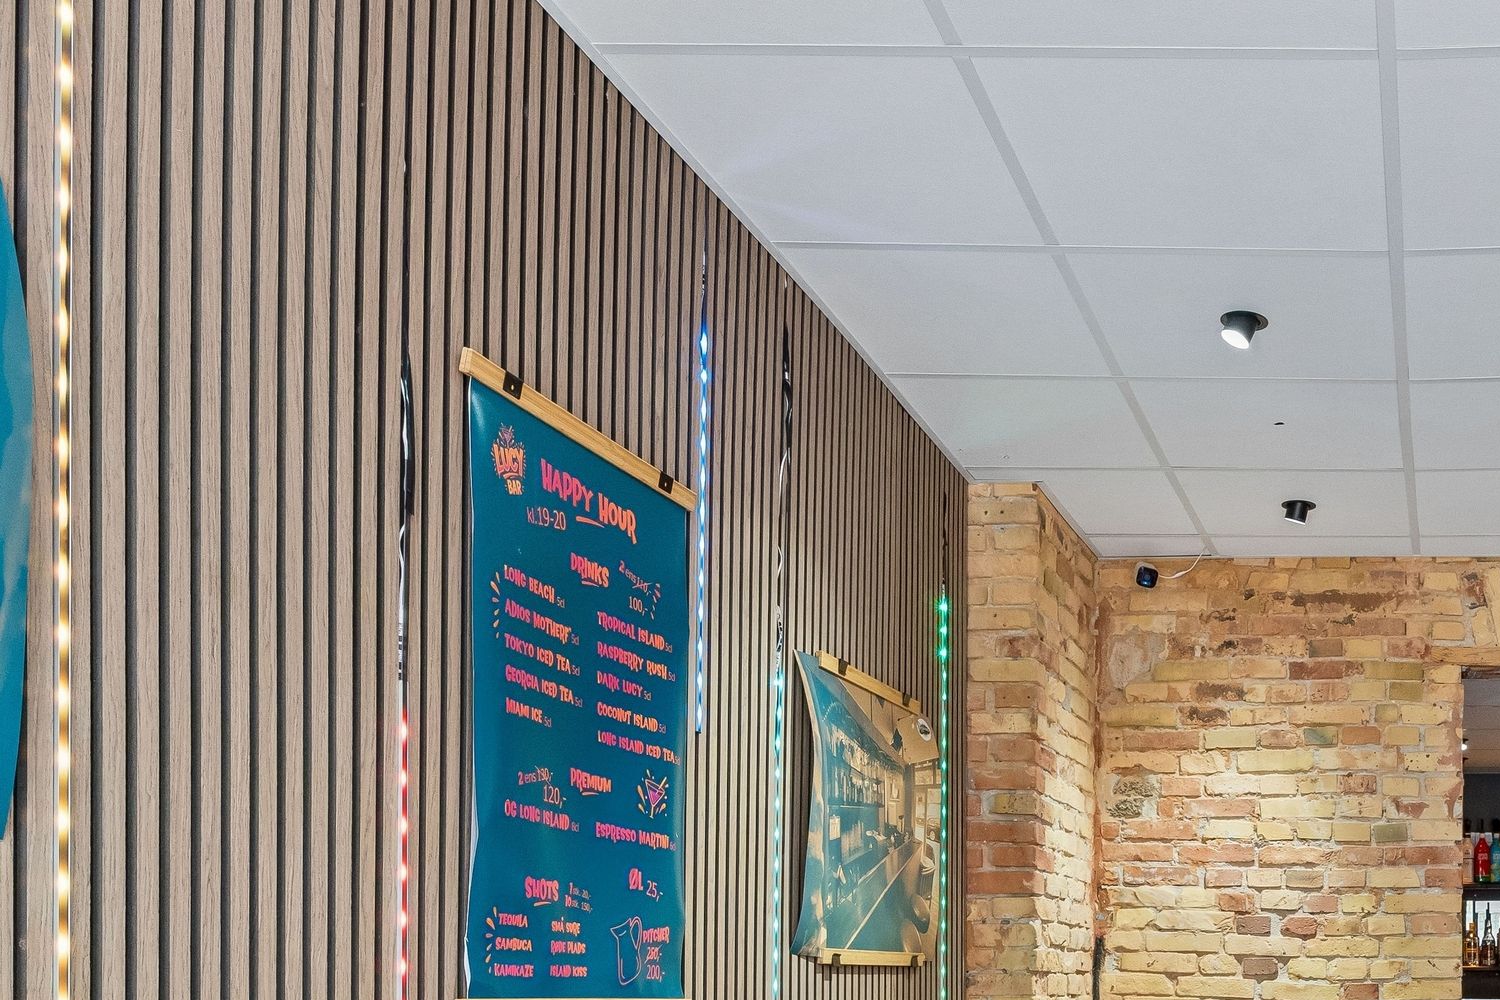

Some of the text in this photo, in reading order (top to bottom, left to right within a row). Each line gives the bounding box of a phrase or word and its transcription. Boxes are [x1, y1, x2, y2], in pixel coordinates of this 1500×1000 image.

[492, 443, 524, 477] LUCY
[507, 480, 523, 495] BAR
[540, 457, 637, 544] HAPPY HOUR
[570, 552, 609, 588] DRINKS
[619, 560, 625, 573] 2
[504, 564, 526, 587] LONG
[529, 576, 555, 604] BEACH
[505, 598, 531, 623] ADIOS
[597, 611, 636, 640] TROPICAL
[638, 627, 665, 650] ISLAND
[504, 632, 534, 658] TOKYO
[536, 646, 554, 667] ICED
[556, 653, 571, 675] TEA
[597, 641, 644, 672] RASPBERRY
[646, 660, 667, 680] RUSH
[505, 664, 539, 692] GEORGIA
[541, 679, 558, 698] ICED
[559, 685, 574, 704] TEA
[596, 670, 620, 692] DARK
[622, 679, 643, 698] LUCY
[505, 697, 530, 717] MIAMI
[531, 707, 543, 723] ICE
[597, 701, 631, 724] COCONUT
[633, 713, 658, 732] ISLAND
[597, 730, 617, 747] LONG
[619, 736, 644, 755] ISLAND
[646, 744, 661, 759] ICED
[662, 748, 675, 764] TEA
[517, 771, 524, 785] 2
[570, 767, 612, 792] PREMIUM
[504, 799, 517, 817] OG
[519, 804, 540, 822] LONG
[542, 810, 570, 831] ISLAND
[595, 821, 637, 843] ESPRESSO
[638, 829, 670, 850] MARTINI
[525, 876, 559, 901] SHOTS
[628, 867, 644, 891] ØL
[498, 913, 528, 928] TEQUILA
[495, 936, 532, 951] SAMBUCA
[642, 926, 670, 943] PITCHER
[494, 962, 534, 977] KAMIKAZE
[550, 964, 588, 977] ISLAND KISS
